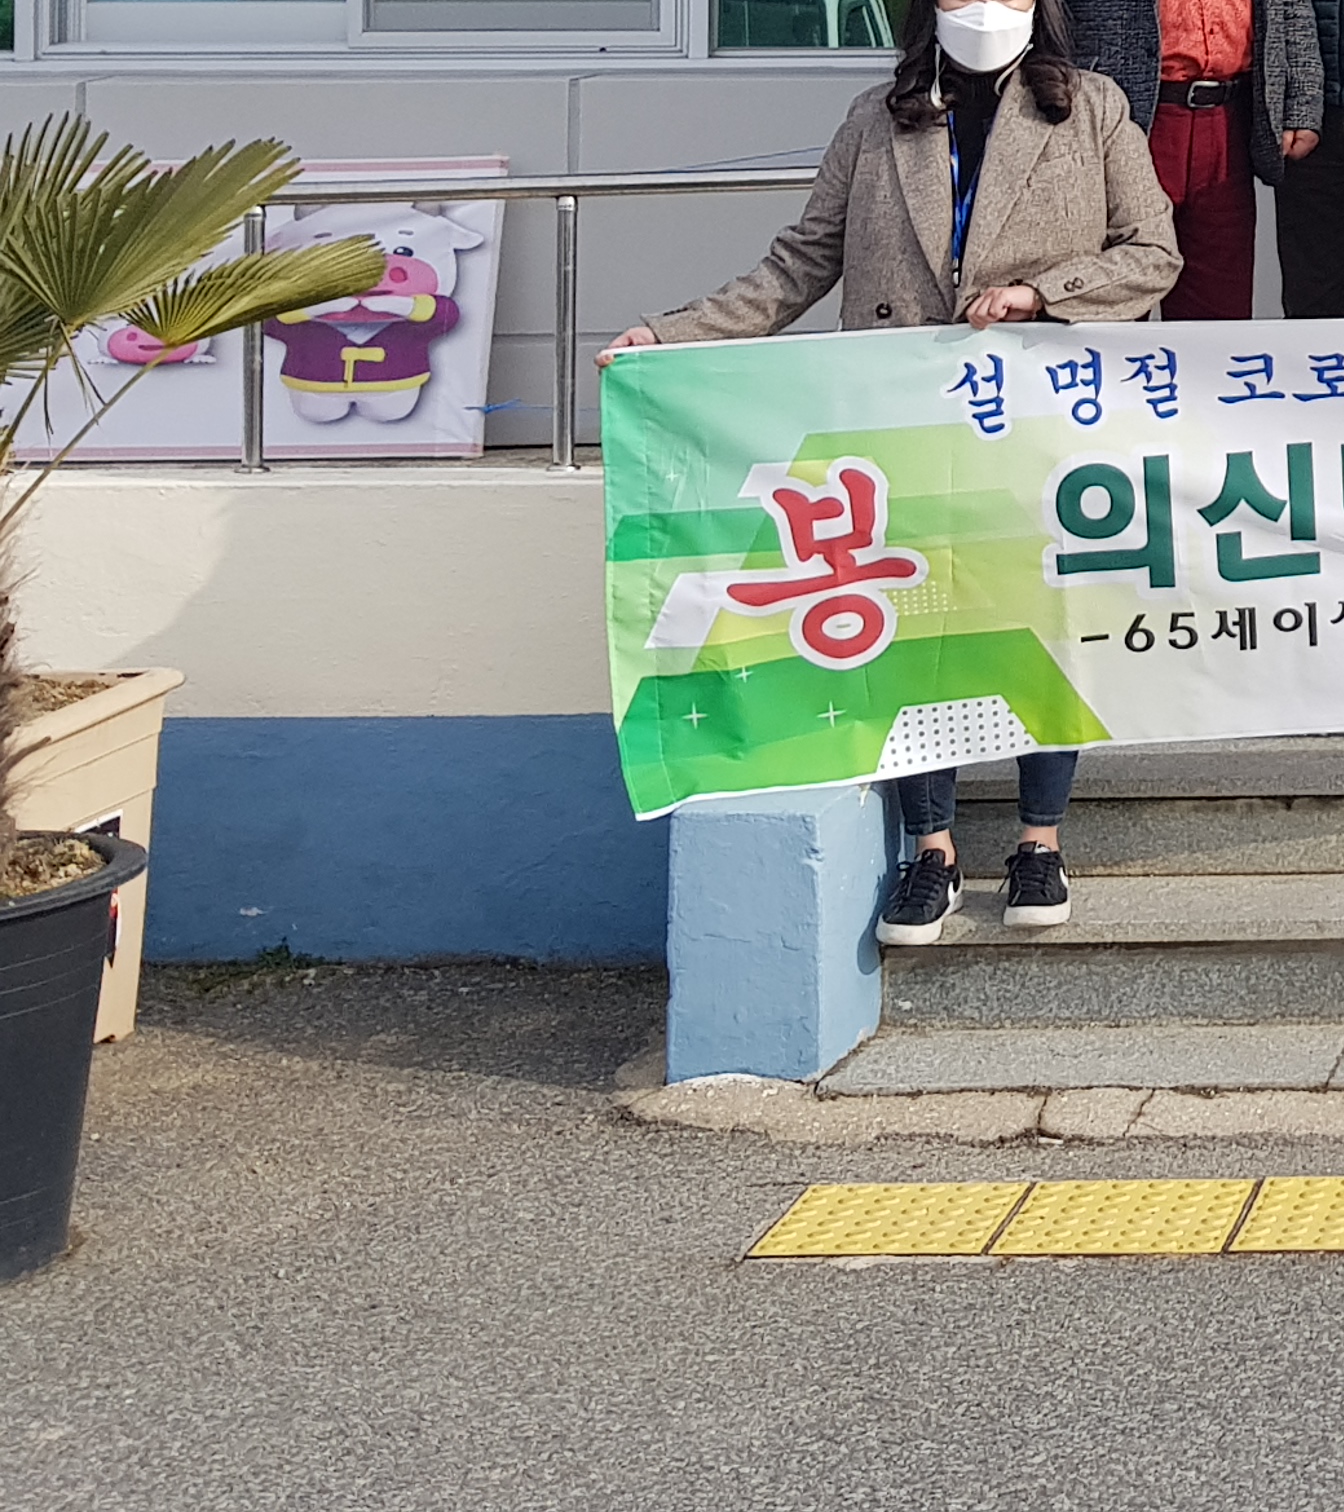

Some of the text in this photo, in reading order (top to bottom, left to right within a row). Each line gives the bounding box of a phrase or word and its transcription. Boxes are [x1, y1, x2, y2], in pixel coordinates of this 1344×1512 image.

[947, 351, 1007, 433] 설
[1046, 345, 1181, 426] 명절
[725, 467, 916, 660] 봉
